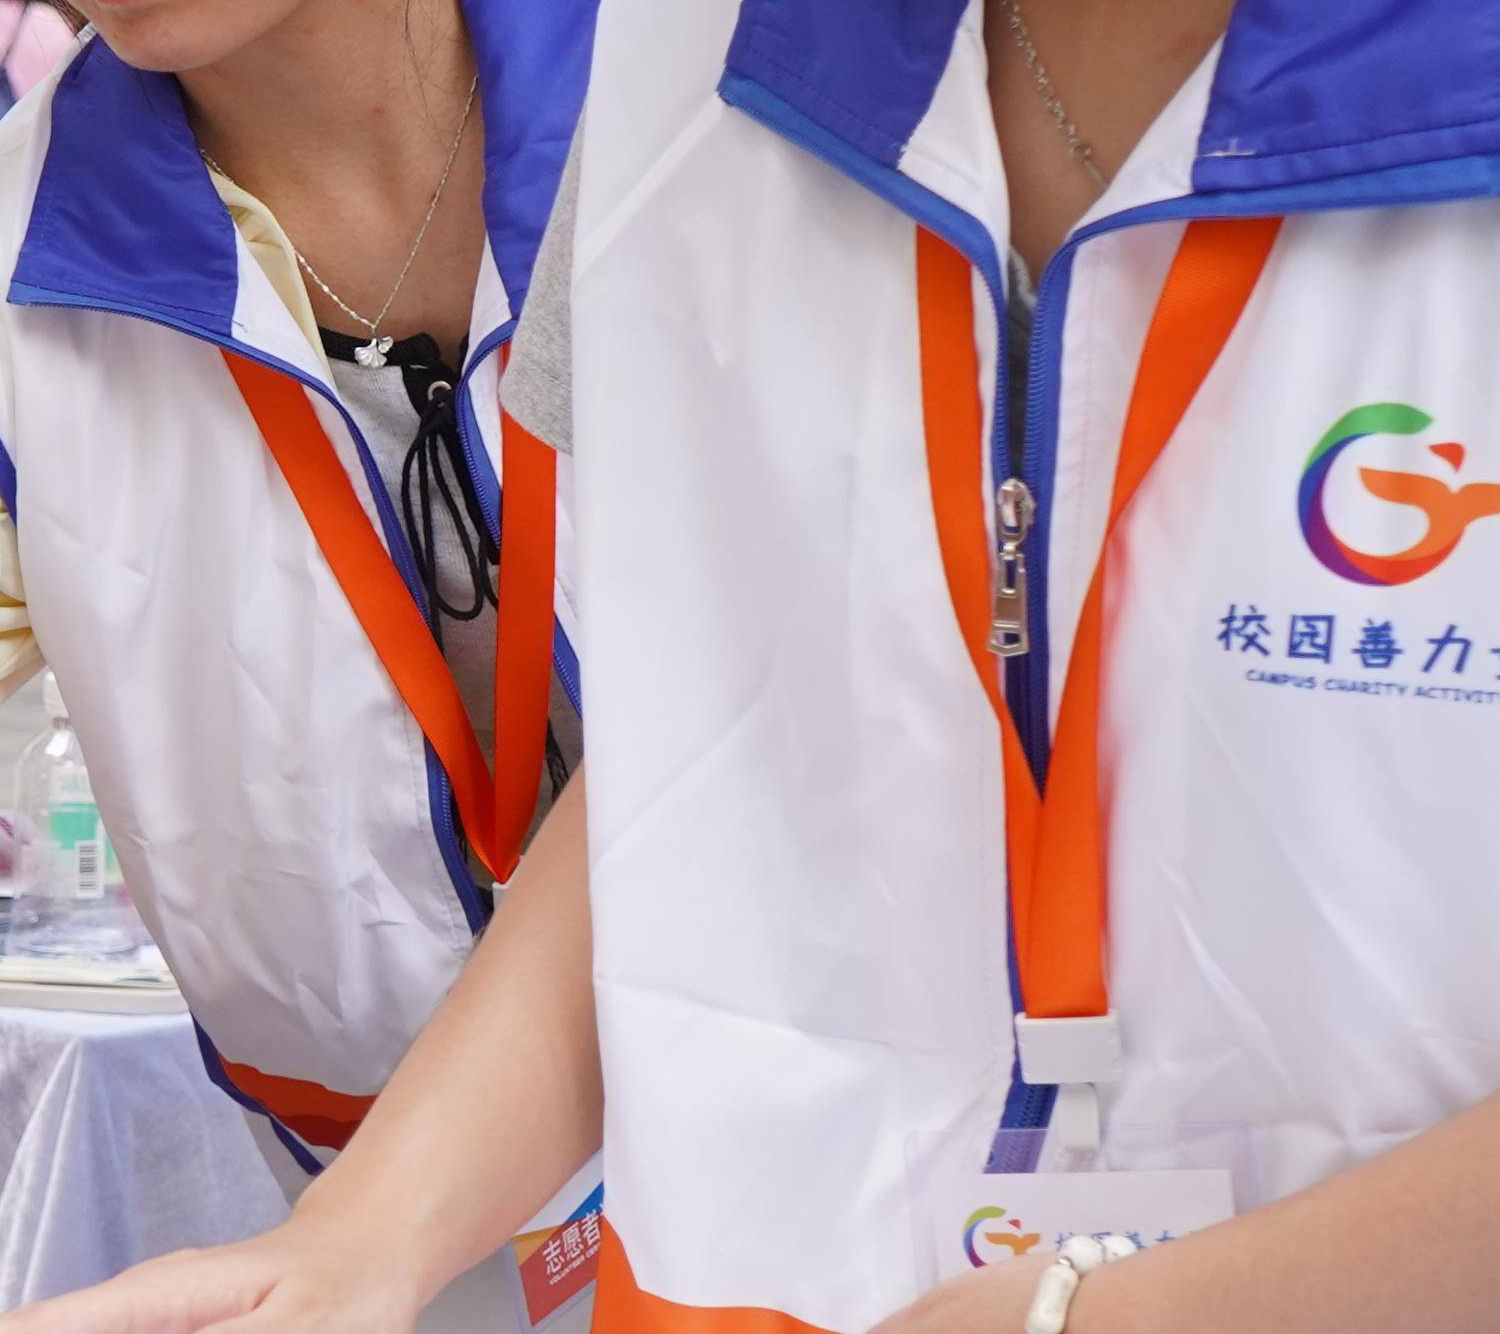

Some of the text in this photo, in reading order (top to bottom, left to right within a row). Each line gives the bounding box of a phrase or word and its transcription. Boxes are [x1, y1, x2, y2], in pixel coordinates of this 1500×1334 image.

[1246, 668, 1318, 690] CAMPUS
[1324, 677, 1408, 698] CHARITY
[542, 1203, 604, 1276] 志愿者
